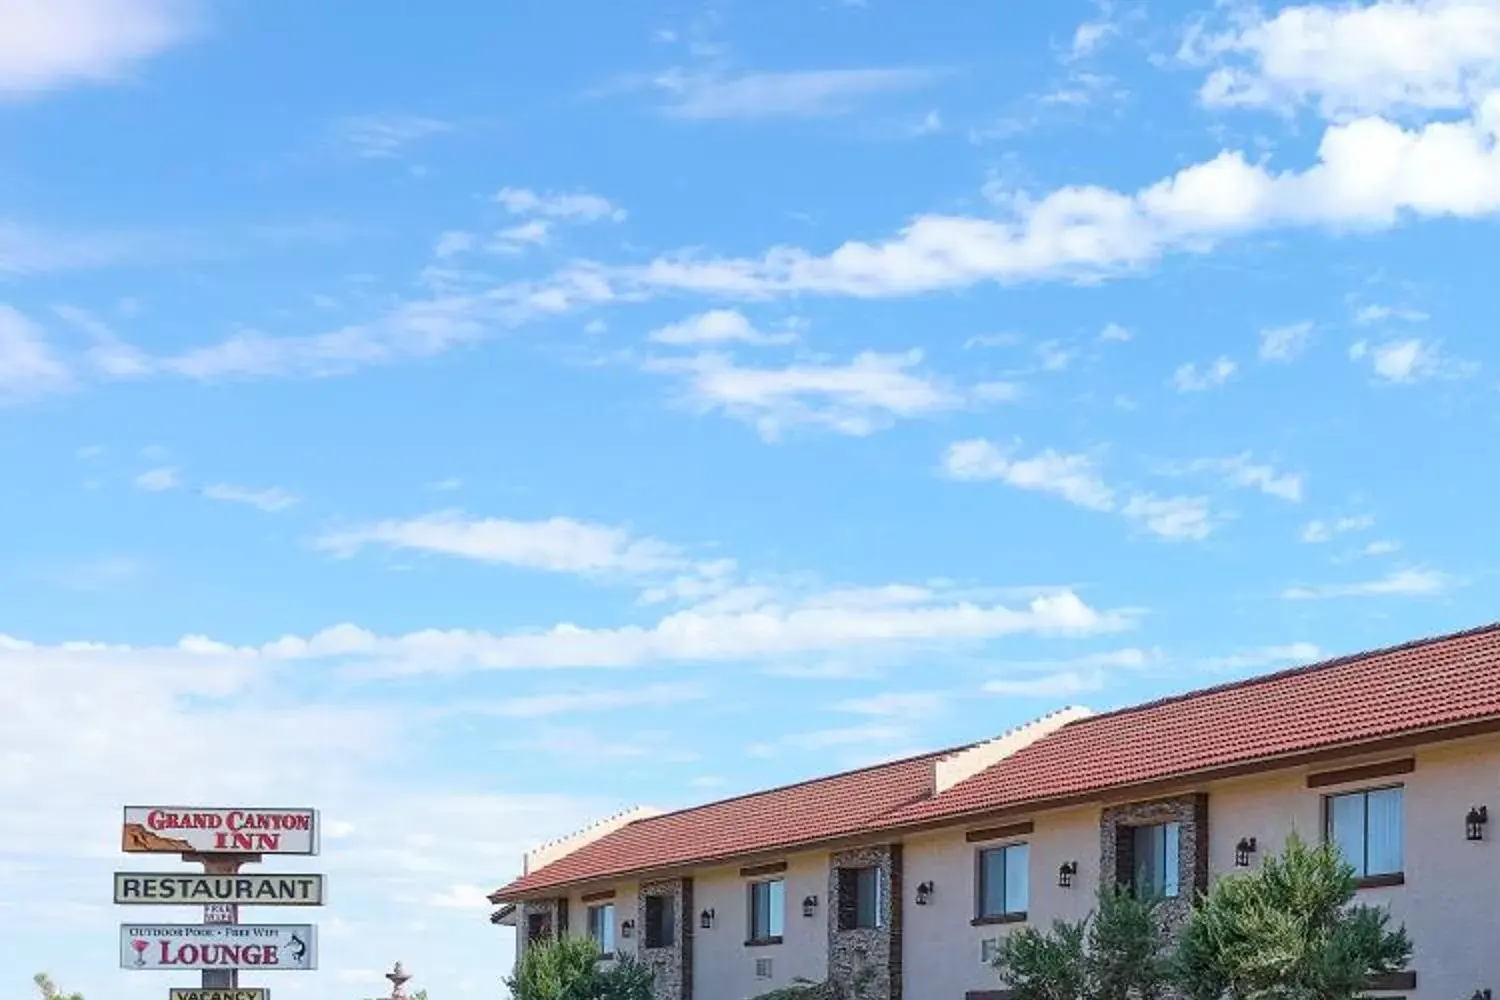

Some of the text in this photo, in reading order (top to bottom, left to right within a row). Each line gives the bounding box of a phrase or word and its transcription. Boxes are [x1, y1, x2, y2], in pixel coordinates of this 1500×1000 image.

[147, 809, 310, 831] GRAND CANYON
[214, 832, 280, 850] INN
[123, 878, 313, 899] RESTAURANT
[158, 939, 279, 965] LOUNGE
